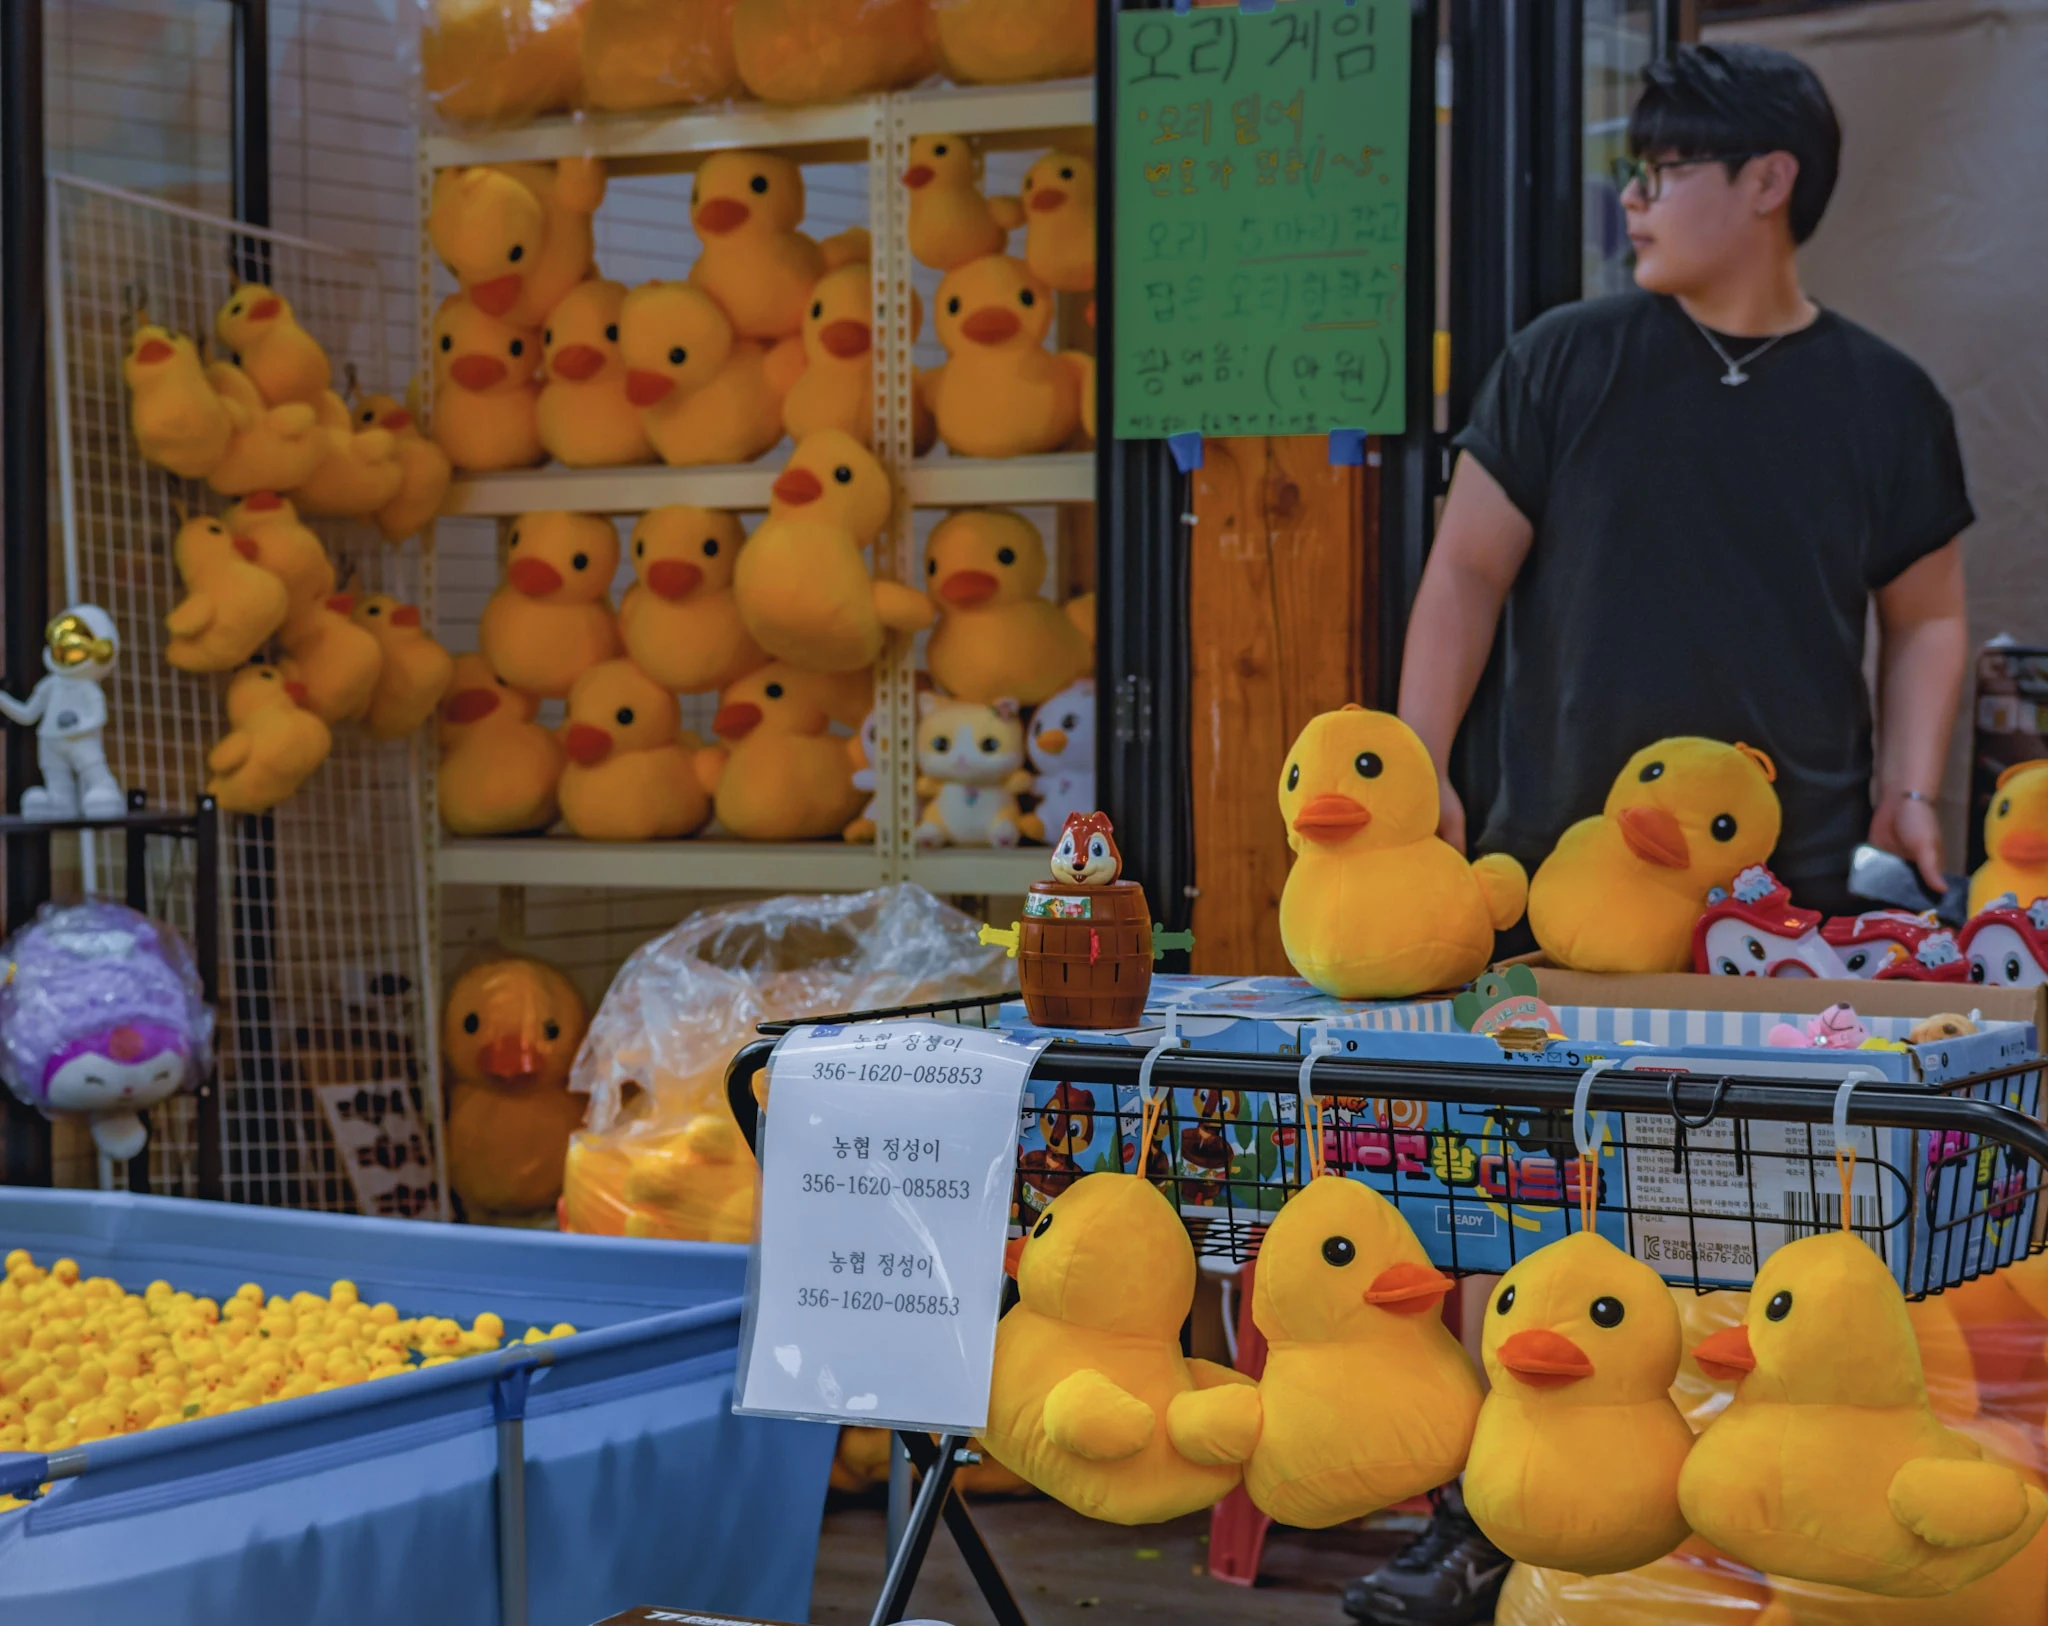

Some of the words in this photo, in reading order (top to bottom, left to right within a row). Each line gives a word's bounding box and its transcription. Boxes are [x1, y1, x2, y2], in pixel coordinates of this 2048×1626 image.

[1128, 17, 1237, 84] 오리
[1266, 6, 1376, 82] 게임
[812, 1062, 983, 1085] 356-1620-085853
[832, 1136, 870, 1160] 농협
[882, 1138, 941, 1163] 정성이
[802, 1173, 971, 1200] 356-1620-085853
[828, 1251, 866, 1275] 농협
[878, 1252, 934, 1279] 정성이
[796, 1286, 961, 1317] 356-1620-085853
